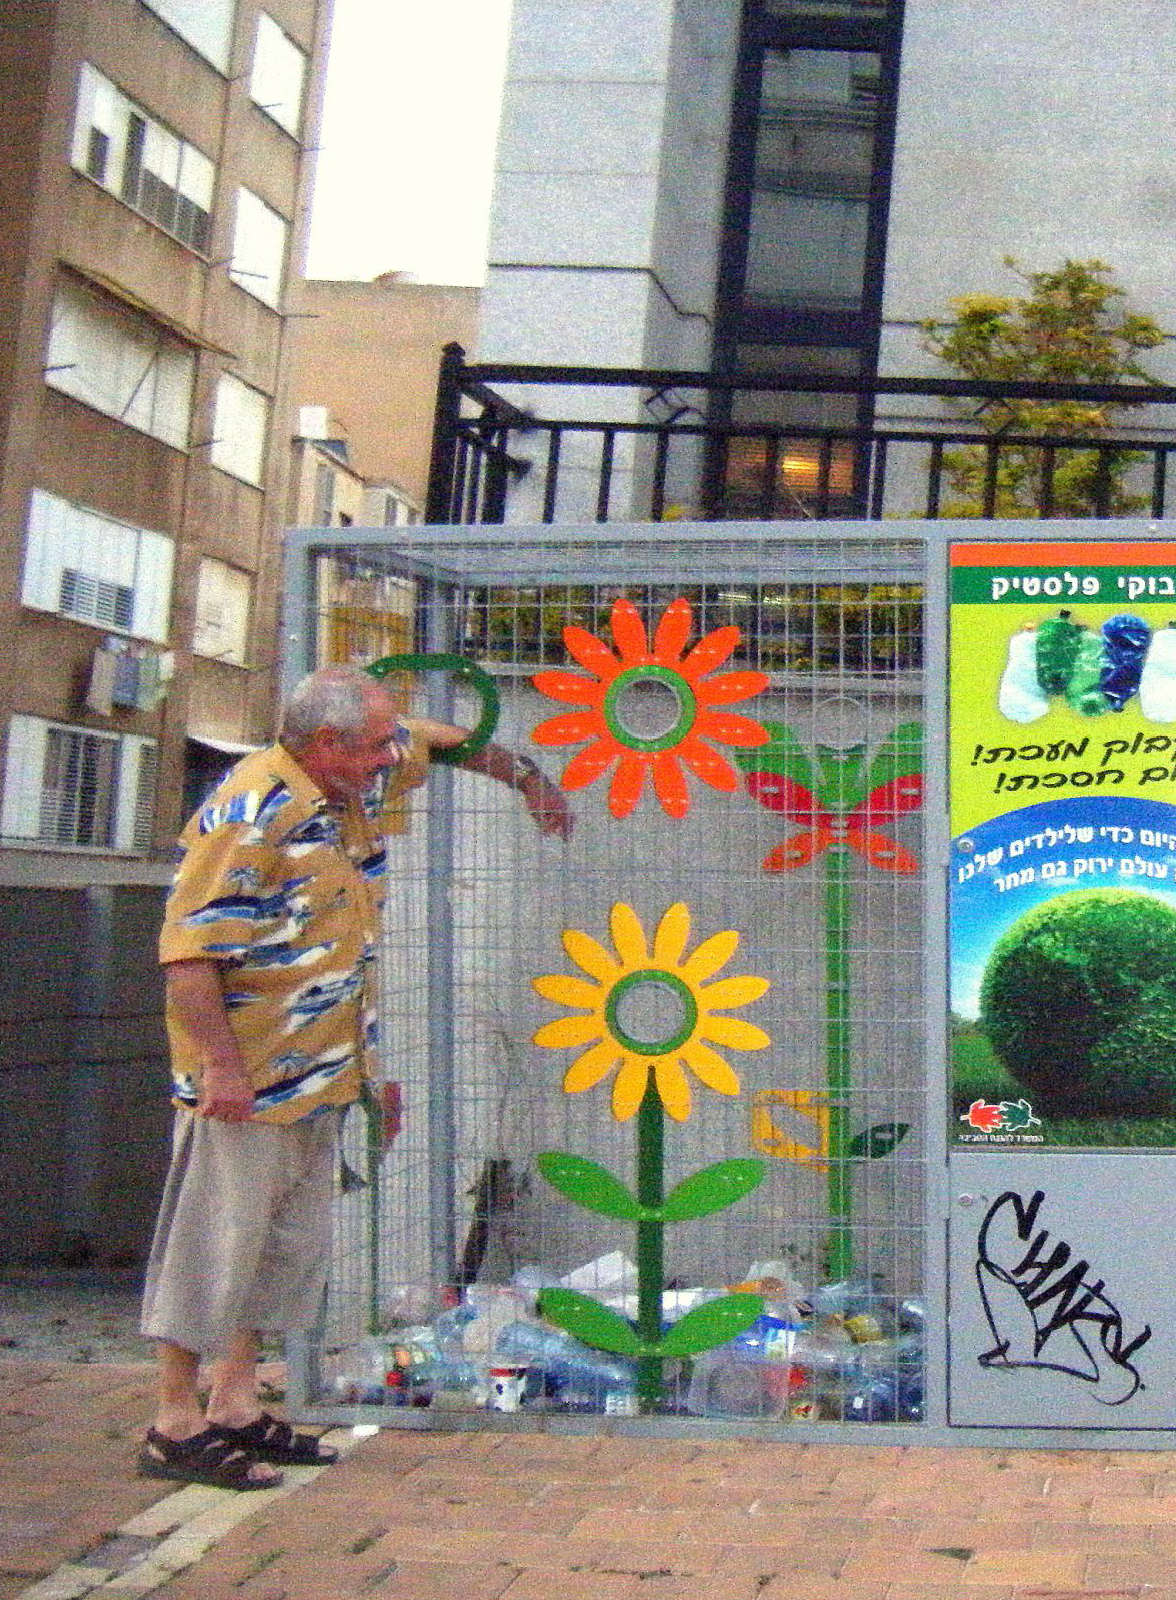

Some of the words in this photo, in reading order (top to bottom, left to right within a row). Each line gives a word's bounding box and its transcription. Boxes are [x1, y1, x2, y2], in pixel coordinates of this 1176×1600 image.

[991, 571, 1101, 600] פלסטיק
[971, 738, 1090, 767] מעכת!
[992, 768, 1125, 795] חסכת!
[1009, 824, 1095, 858] שלילדים
[1100, 825, 1134, 844] כדי
[957, 848, 1005, 884] שלנו
[1040, 860, 1068, 880] גם
[1073, 857, 1116, 879] ירוק
[1120, 855, 1169, 884] עולם
[993, 868, 1035, 893] מחר
